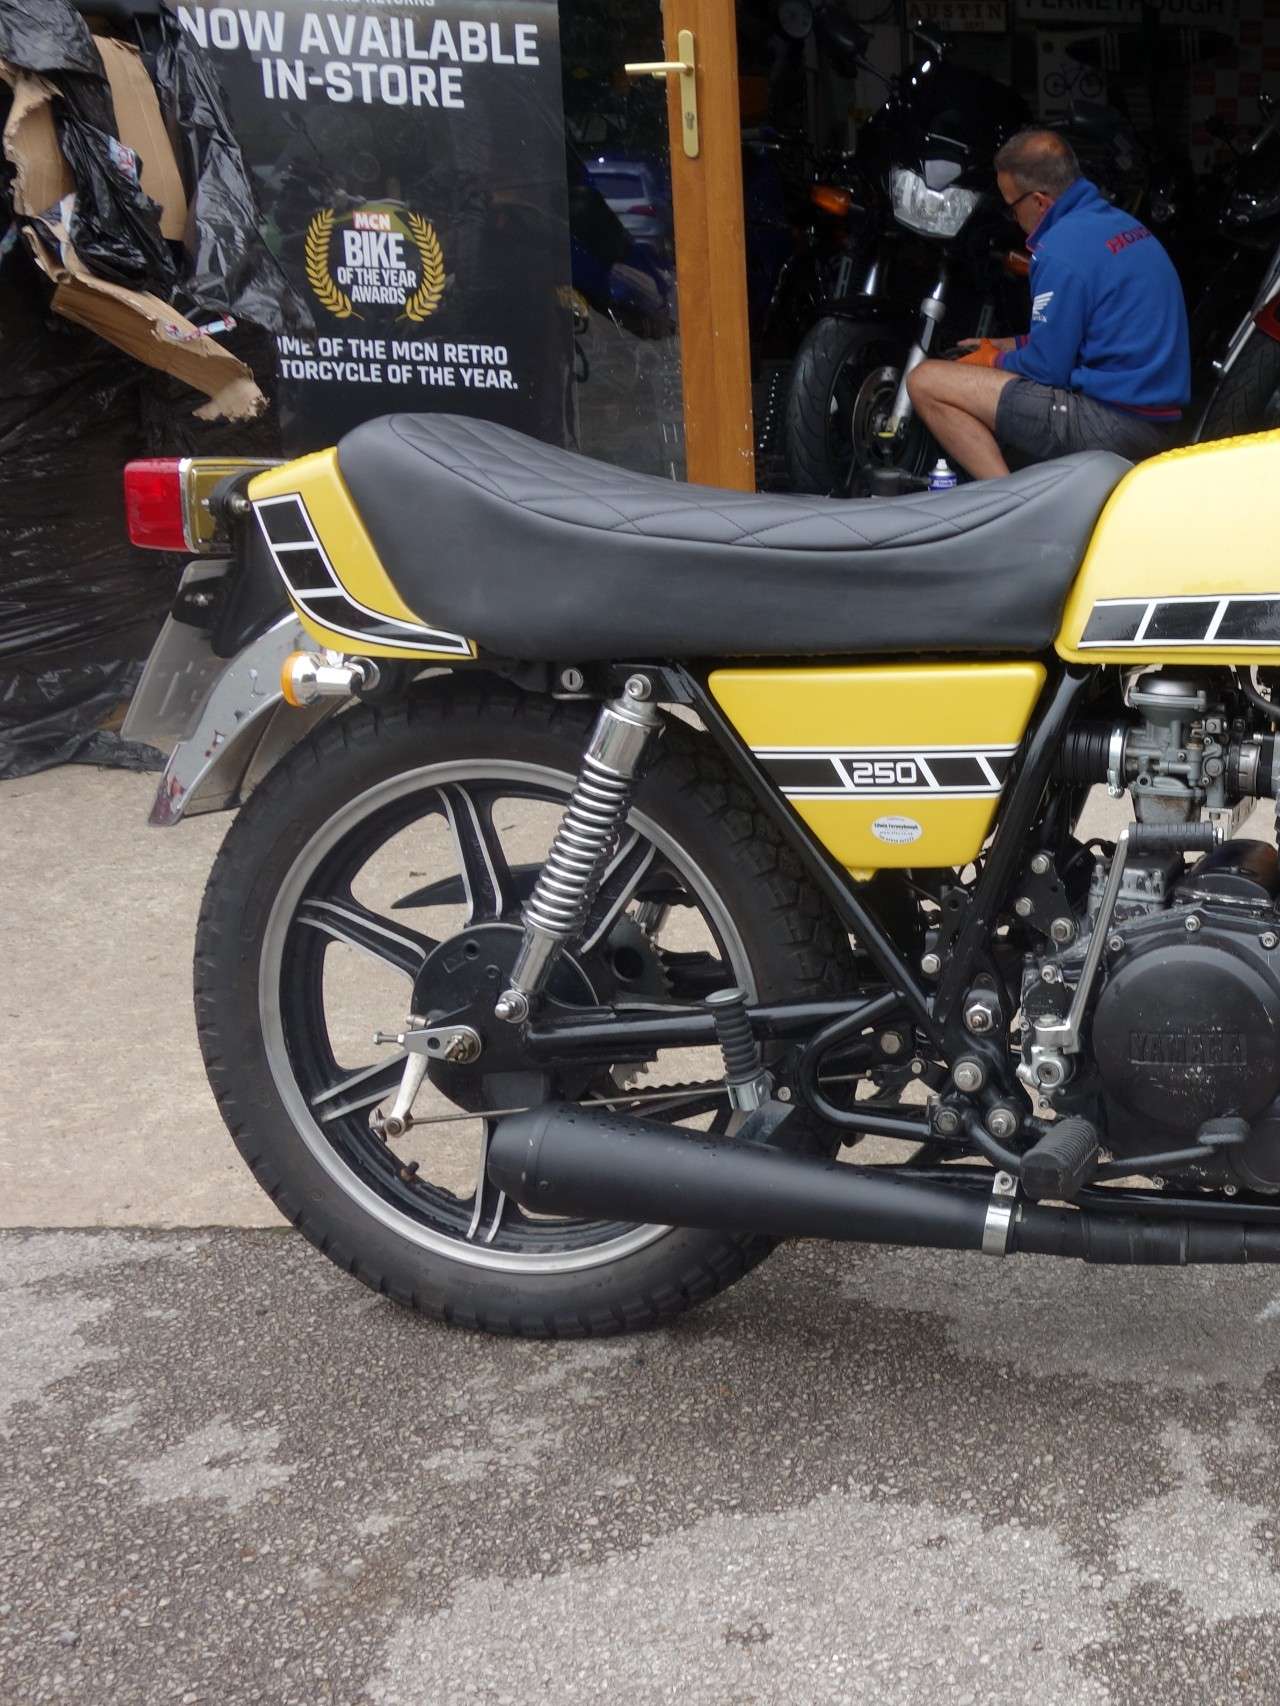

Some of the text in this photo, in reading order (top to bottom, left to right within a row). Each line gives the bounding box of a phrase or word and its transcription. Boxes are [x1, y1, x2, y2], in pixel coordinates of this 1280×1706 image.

[178, 6, 540, 65] NOW AVAILABLE
[262, 58, 464, 108] IN-STORE
[354, 212, 390, 229] MCN
[343, 230, 406, 269] BIKE
[1106, 226, 1151, 255] HON
[338, 267, 417, 288] OF THE YEAR
[351, 286, 406, 305] AWARDS
[318, 337, 344, 357] OF
[348, 339, 387, 359] THE
[392, 340, 438, 362] MCN
[444, 343, 507, 365] RETRO
[276, 359, 518, 389] TORCYCLE OF THE YEAR.
[852, 762, 917, 784] 250
